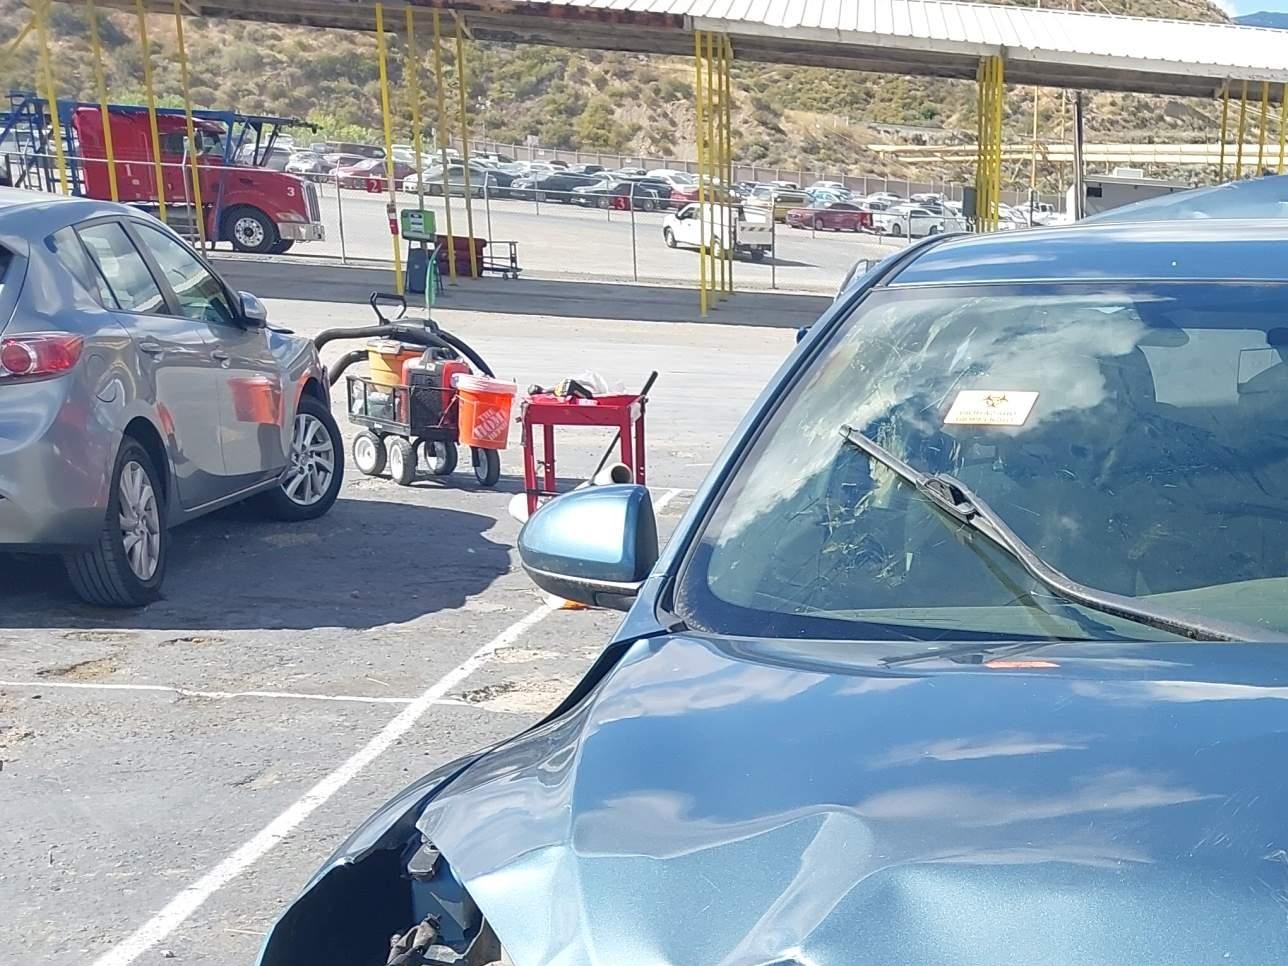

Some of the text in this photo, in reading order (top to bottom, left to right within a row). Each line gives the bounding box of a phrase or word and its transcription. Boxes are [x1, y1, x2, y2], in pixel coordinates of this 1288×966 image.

[286, 187, 295, 197] 3
[370, 180, 378, 192] 2
[617, 197, 625, 210] 3
